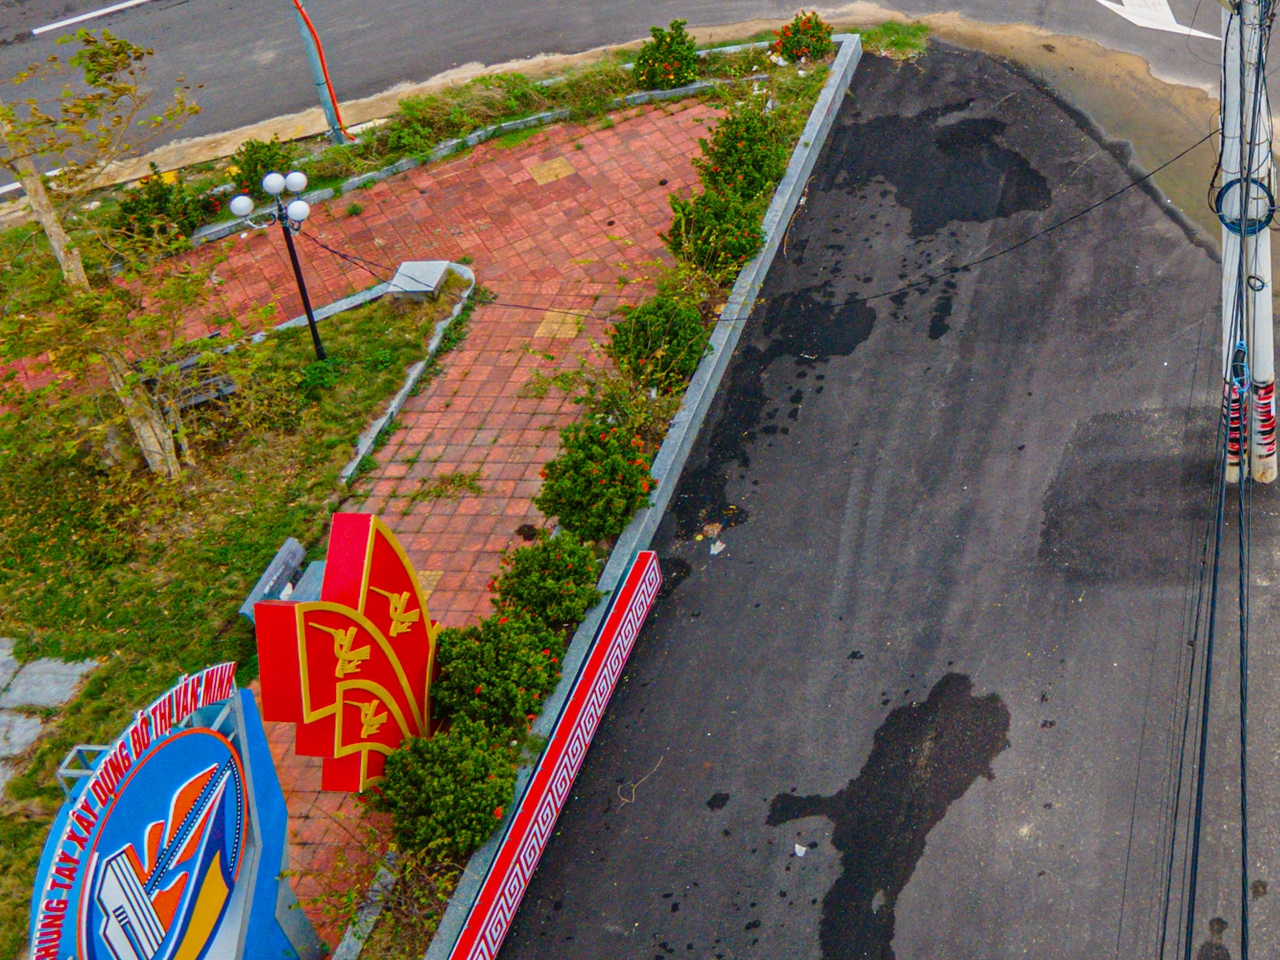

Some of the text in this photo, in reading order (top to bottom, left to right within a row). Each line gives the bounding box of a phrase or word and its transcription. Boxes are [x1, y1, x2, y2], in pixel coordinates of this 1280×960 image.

[173, 672, 201, 724] VĂN
[200, 661, 236, 708] MINH
[150, 692, 173, 741] THỊ
[89, 740, 132, 808] DỰNG
[63, 796, 99, 851] XÂY
[47, 849, 81, 891] TAY
[34, 899, 69, 960] HUNG
